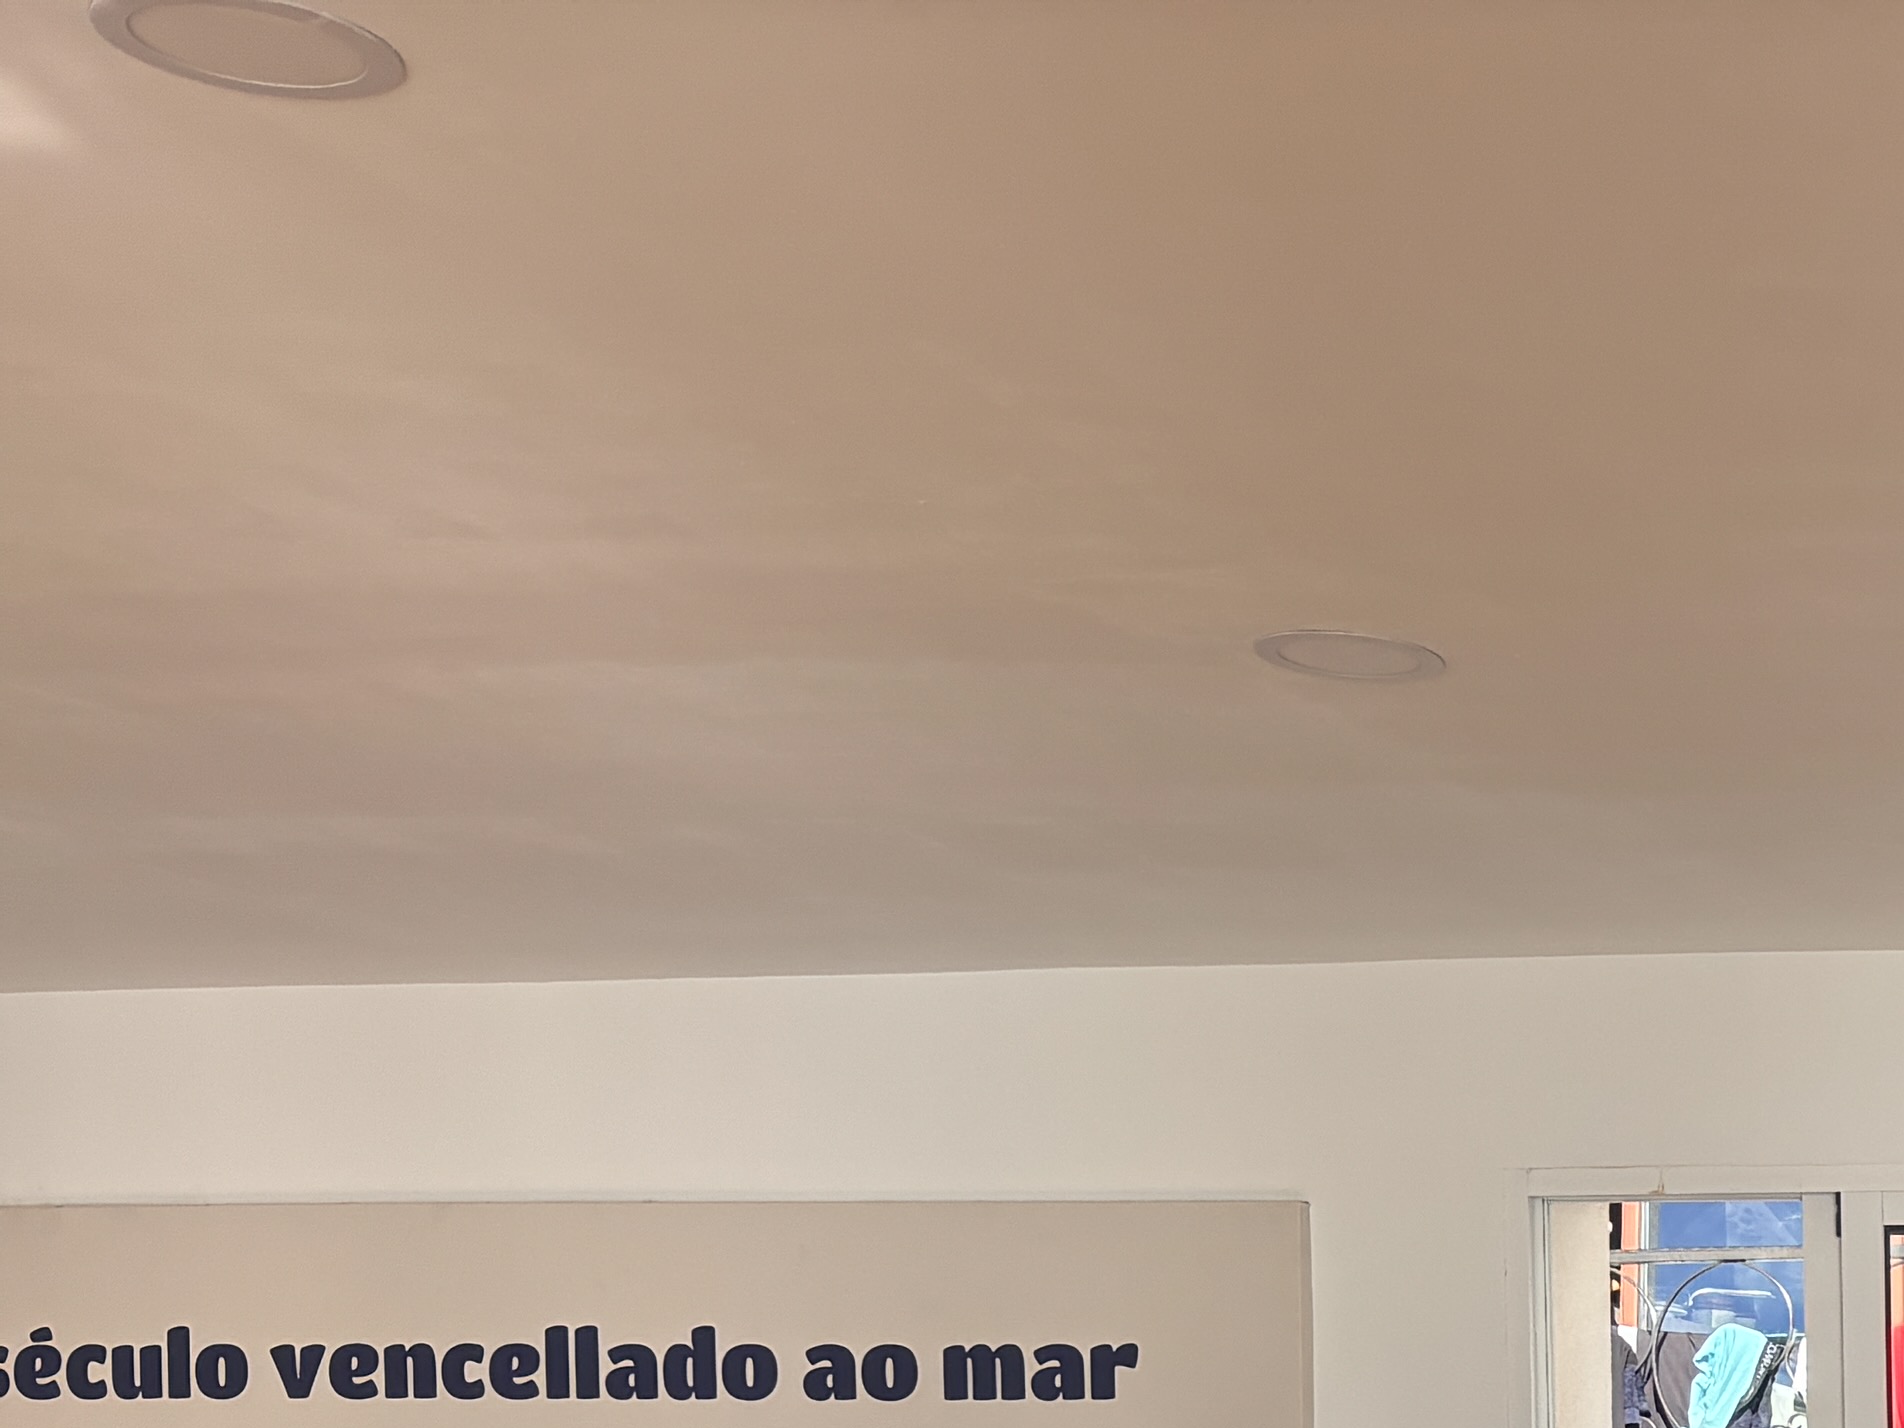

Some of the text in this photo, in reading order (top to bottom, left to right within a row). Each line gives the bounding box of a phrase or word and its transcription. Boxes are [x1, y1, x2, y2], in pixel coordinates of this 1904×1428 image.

[270, 1325, 778, 1400] vencellado
[803, 1343, 918, 1400] ao
[943, 1343, 1138, 1400] mar
